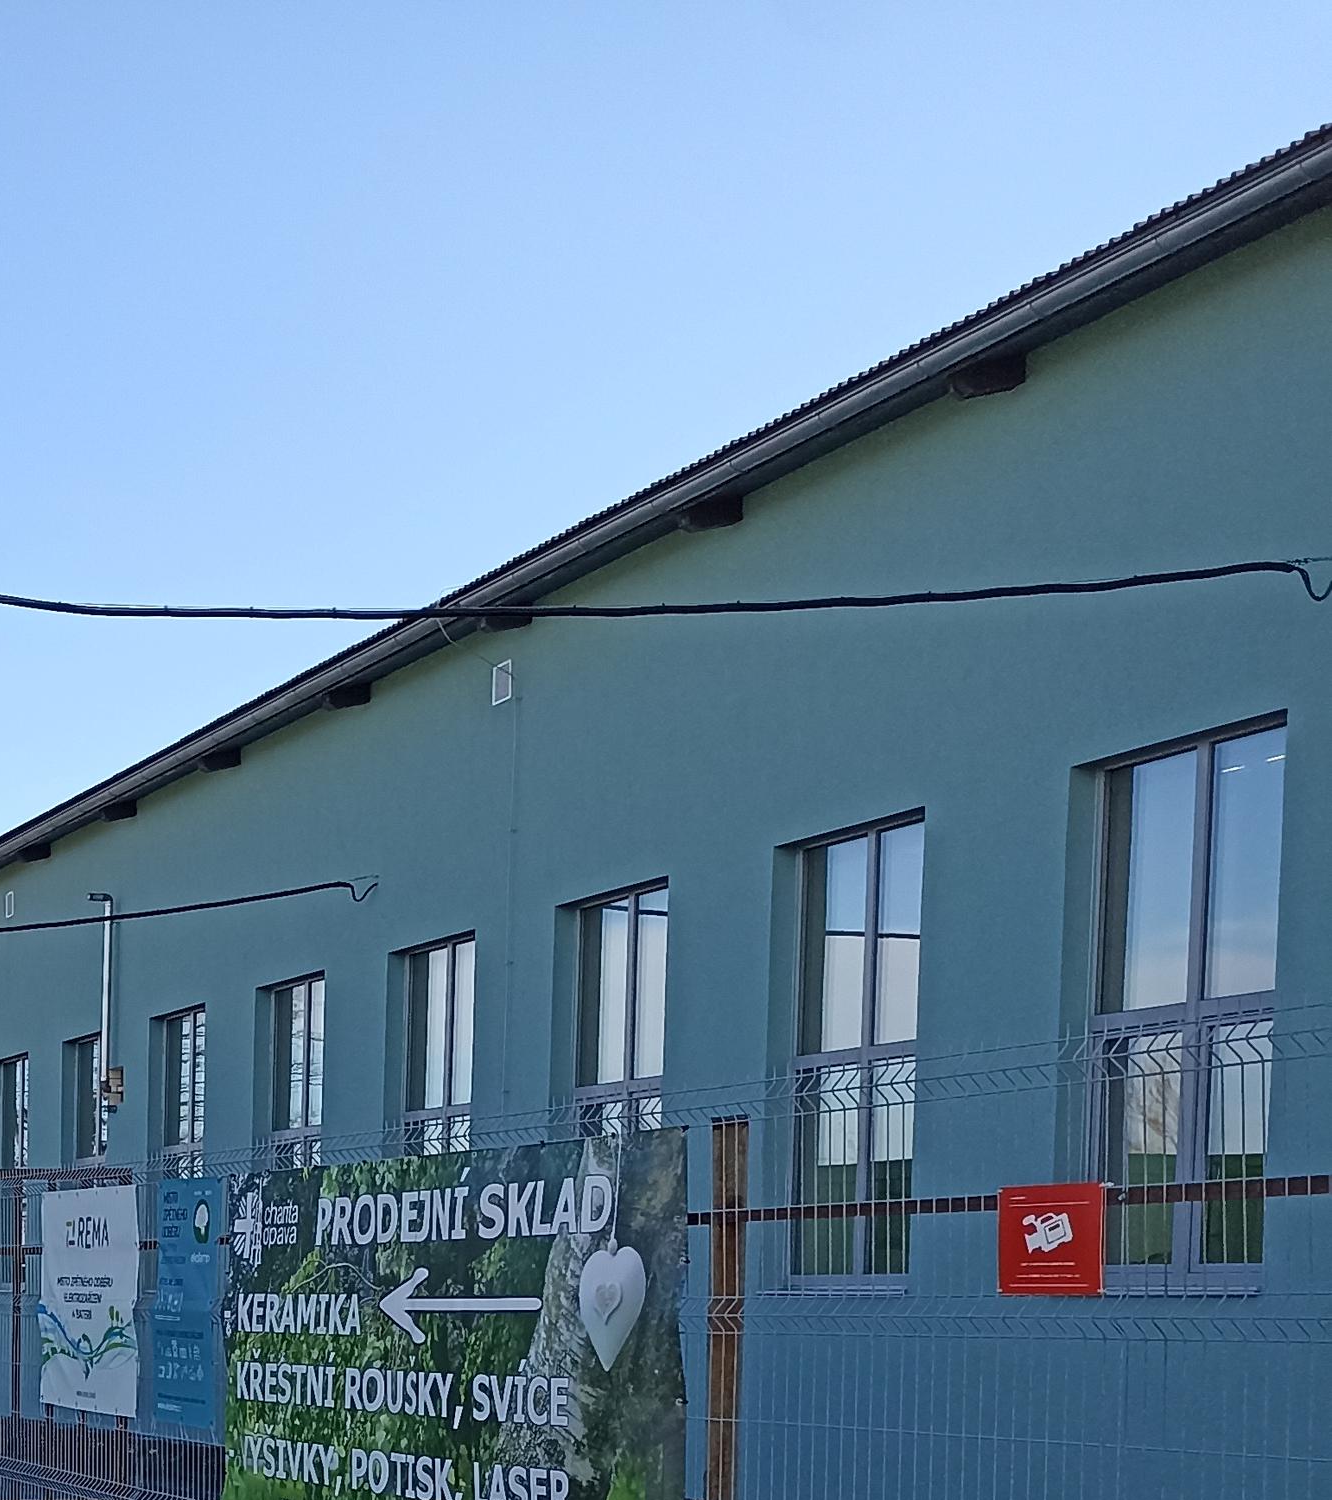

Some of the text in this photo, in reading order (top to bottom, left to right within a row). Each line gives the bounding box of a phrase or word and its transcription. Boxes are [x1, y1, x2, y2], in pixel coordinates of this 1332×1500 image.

[264, 1200, 299, 1225] charita
[314, 1167, 614, 1246] PRODEJNÍ SKLAD
[77, 1217, 109, 1249] REMA
[262, 1225, 297, 1247] opava
[237, 1293, 361, 1335] KERAMIKA
[237, 1348, 569, 1430] KŘESTNÍ ROUŠKY, SVÍCE
